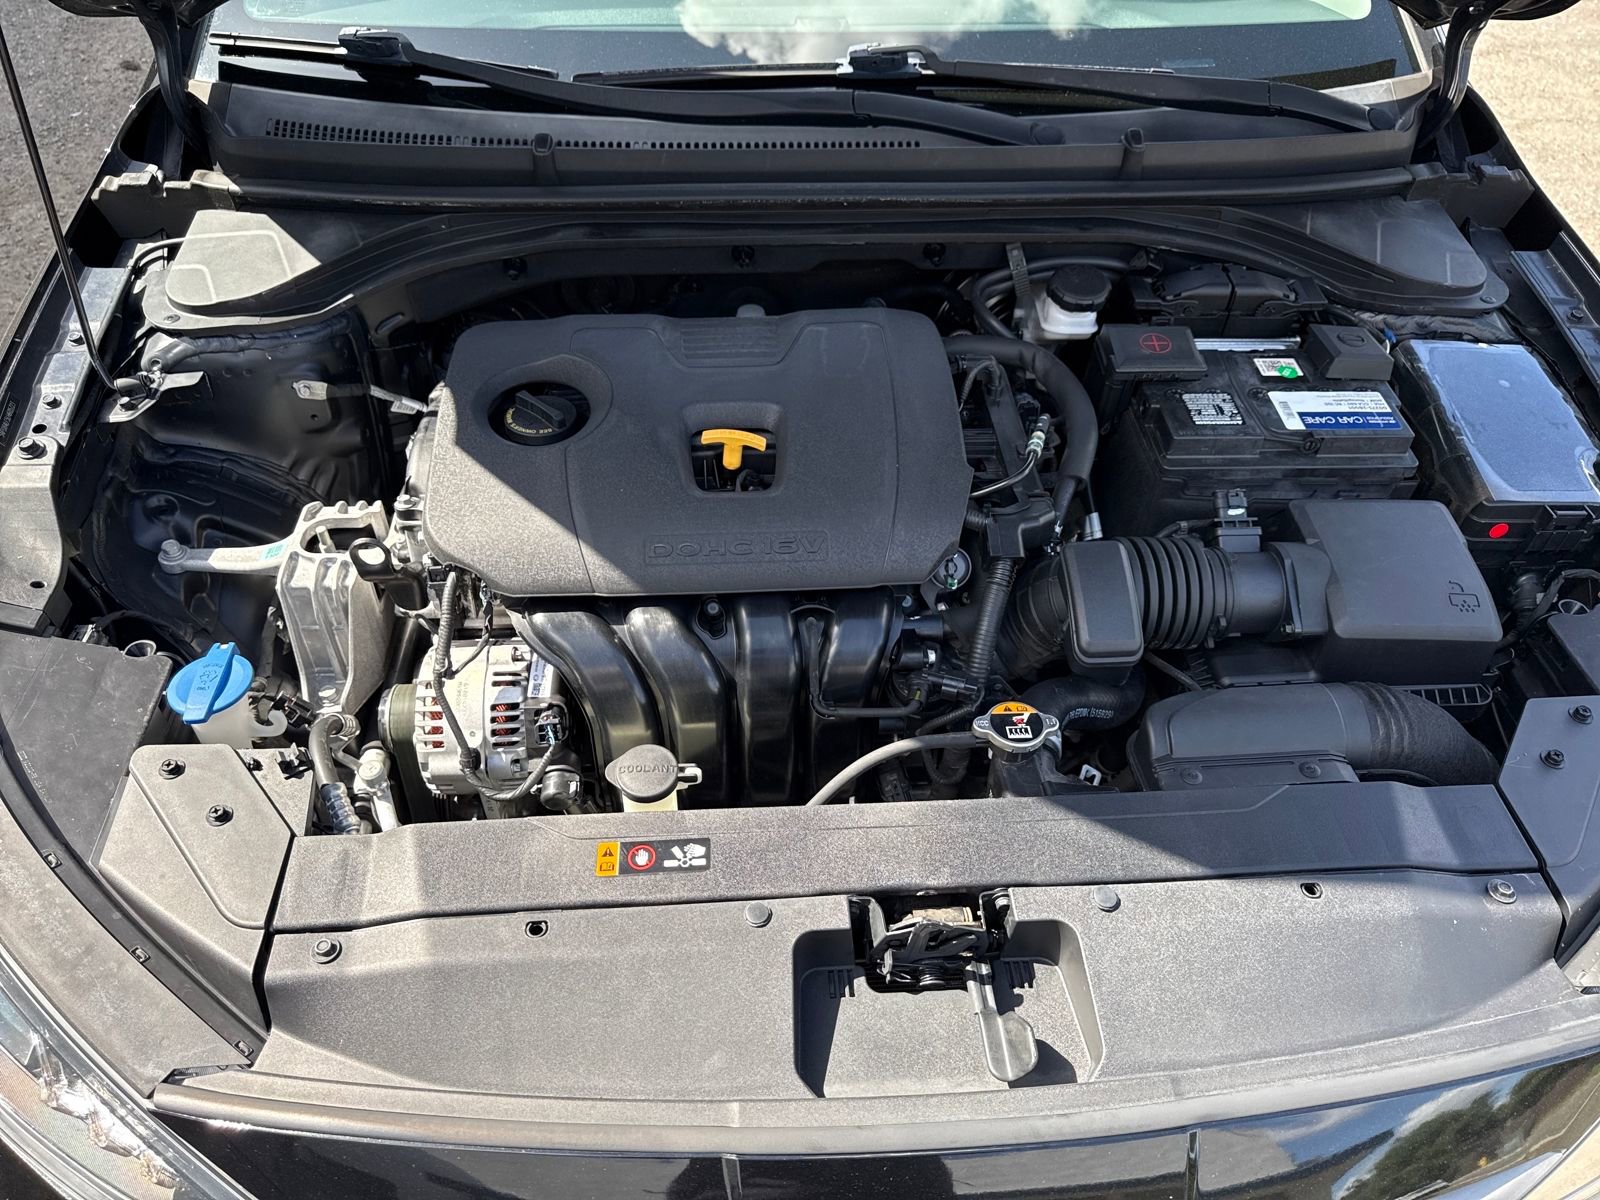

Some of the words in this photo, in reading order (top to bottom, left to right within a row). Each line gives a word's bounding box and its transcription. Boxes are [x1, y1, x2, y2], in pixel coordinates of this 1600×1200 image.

[1302, 415, 1336, 424] CARE
[1336, 415, 1363, 424] CAR
[647, 539, 754, 558] DOHC
[618, 764, 679, 774] COOLANT
